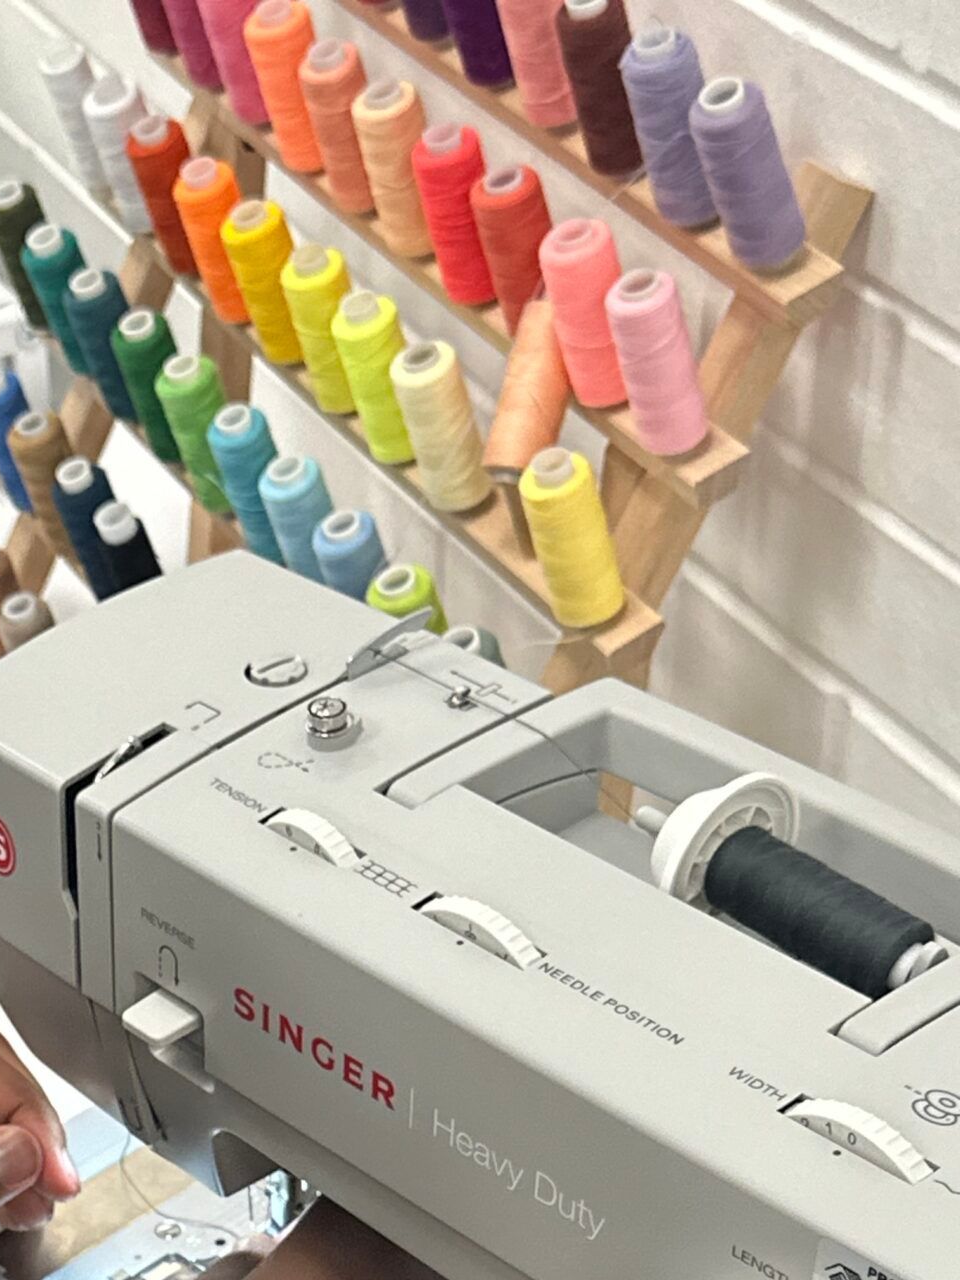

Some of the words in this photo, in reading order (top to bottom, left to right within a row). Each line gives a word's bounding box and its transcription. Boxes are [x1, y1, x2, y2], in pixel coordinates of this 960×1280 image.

[210, 778, 268, 813] TENSION
[140, 907, 196, 949] REVERSE
[539, 962, 605, 1001] NEEDLE
[603, 998, 685, 1045] POSITION
[728, 1066, 788, 1102] WIDTH
[233, 987, 397, 1111] SINGER
[433, 1108, 524, 1191] Heavy
[533, 1170, 605, 1240] Duty
[825, 1122, 833, 1135] 1
[847, 1132, 856, 1145] 0
